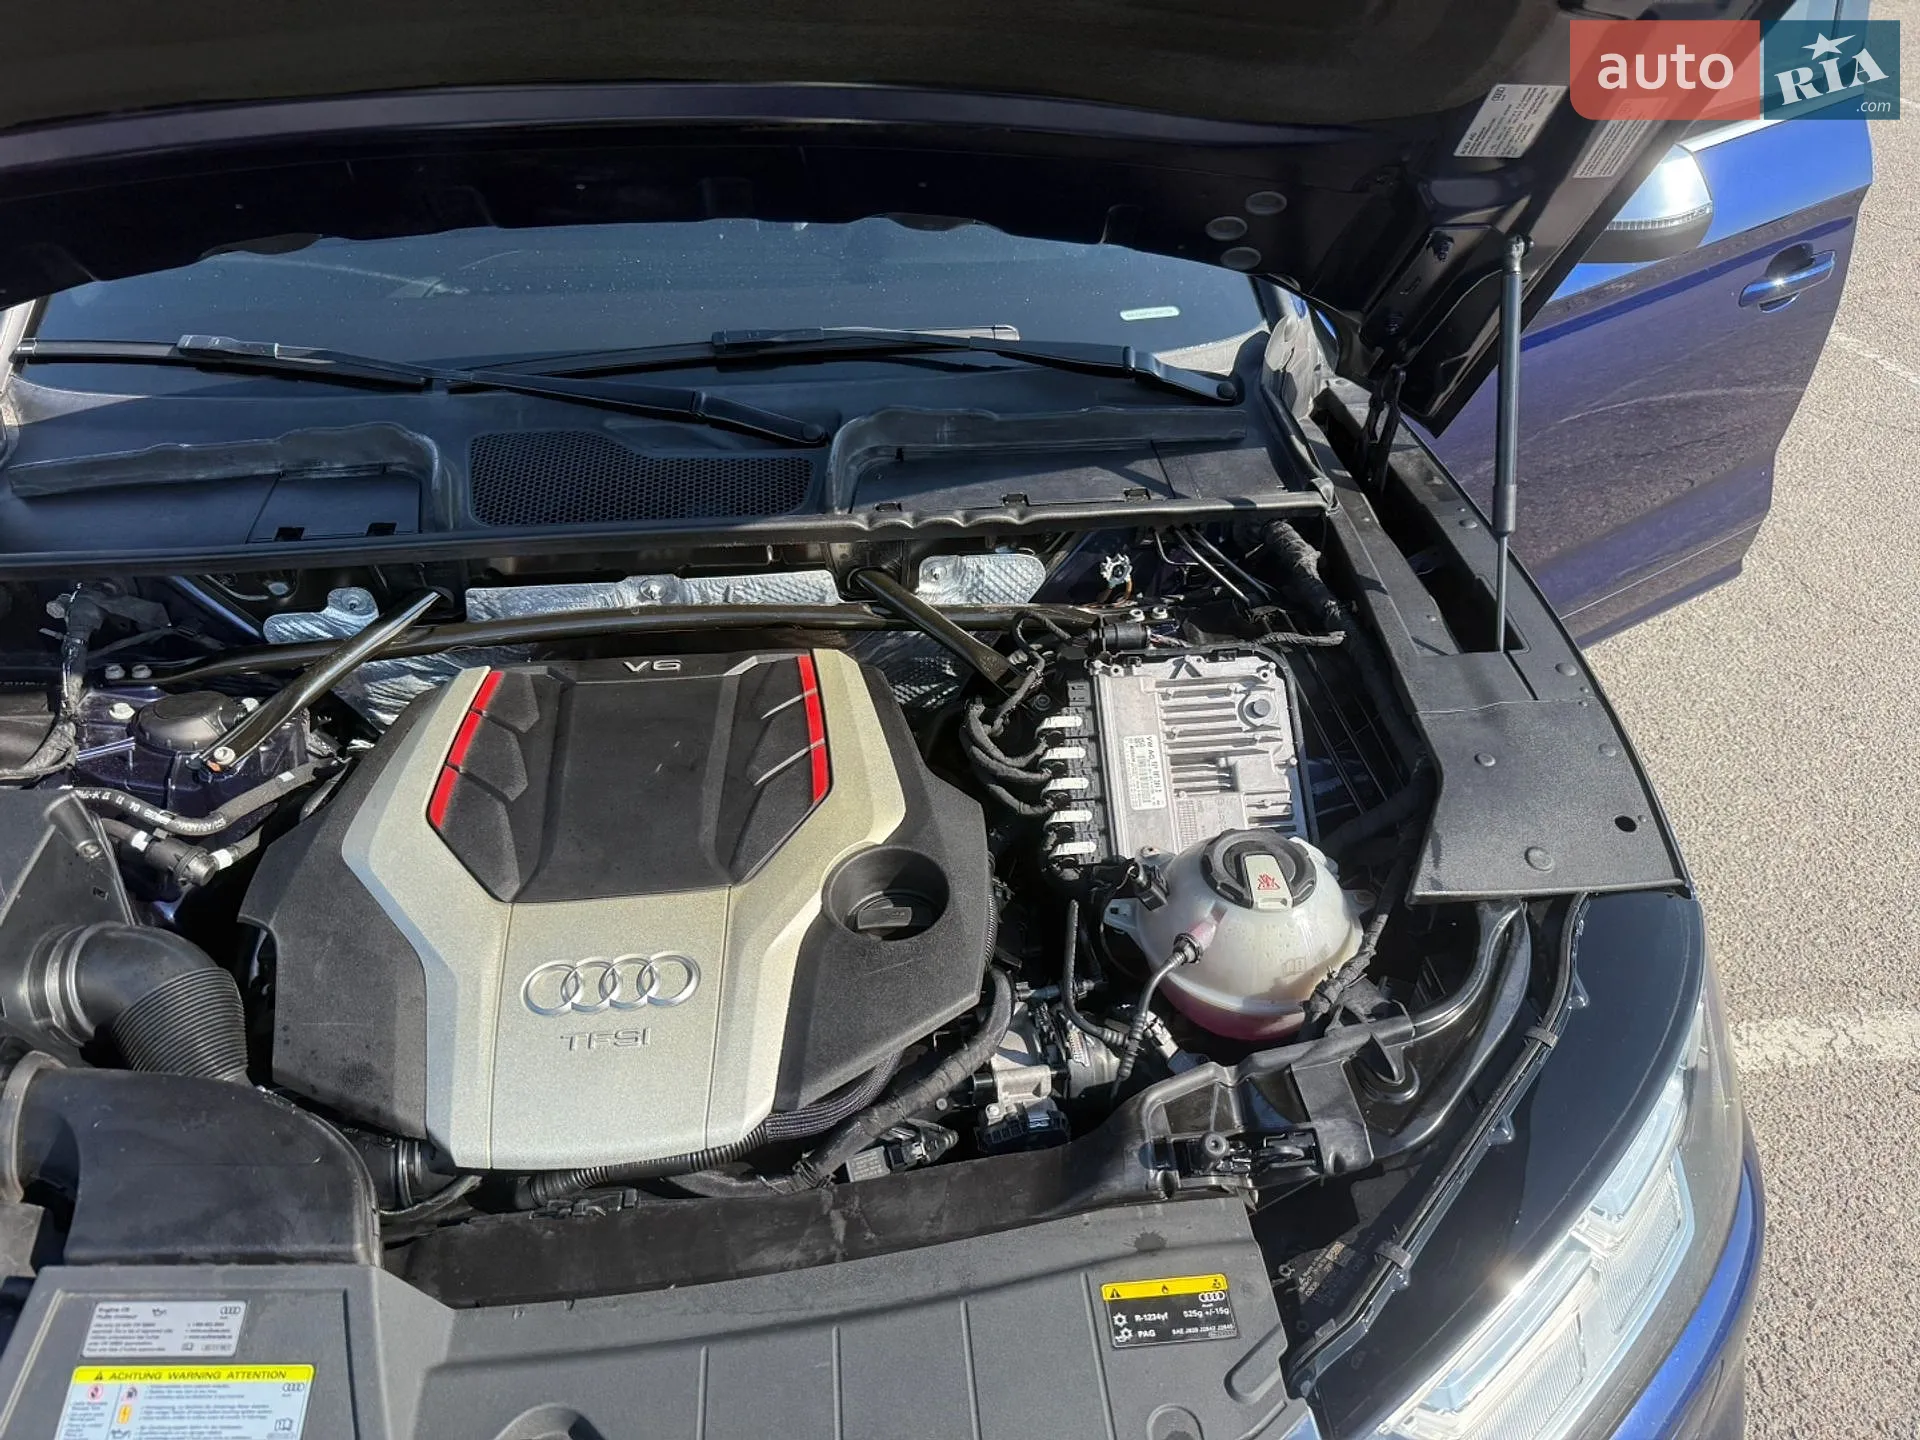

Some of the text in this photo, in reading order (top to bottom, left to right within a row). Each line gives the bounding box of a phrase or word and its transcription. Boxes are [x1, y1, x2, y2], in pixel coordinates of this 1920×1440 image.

[623, 659, 681, 672] V6
[560, 1027, 651, 1051] TFSI
[1134, 1308, 1230, 1322] R-1234yf 525g +/-15g
[1137, 1329, 1156, 1338] PAG
[109, 1370, 287, 1381] ACHTUNG WARNING ATTENTION
